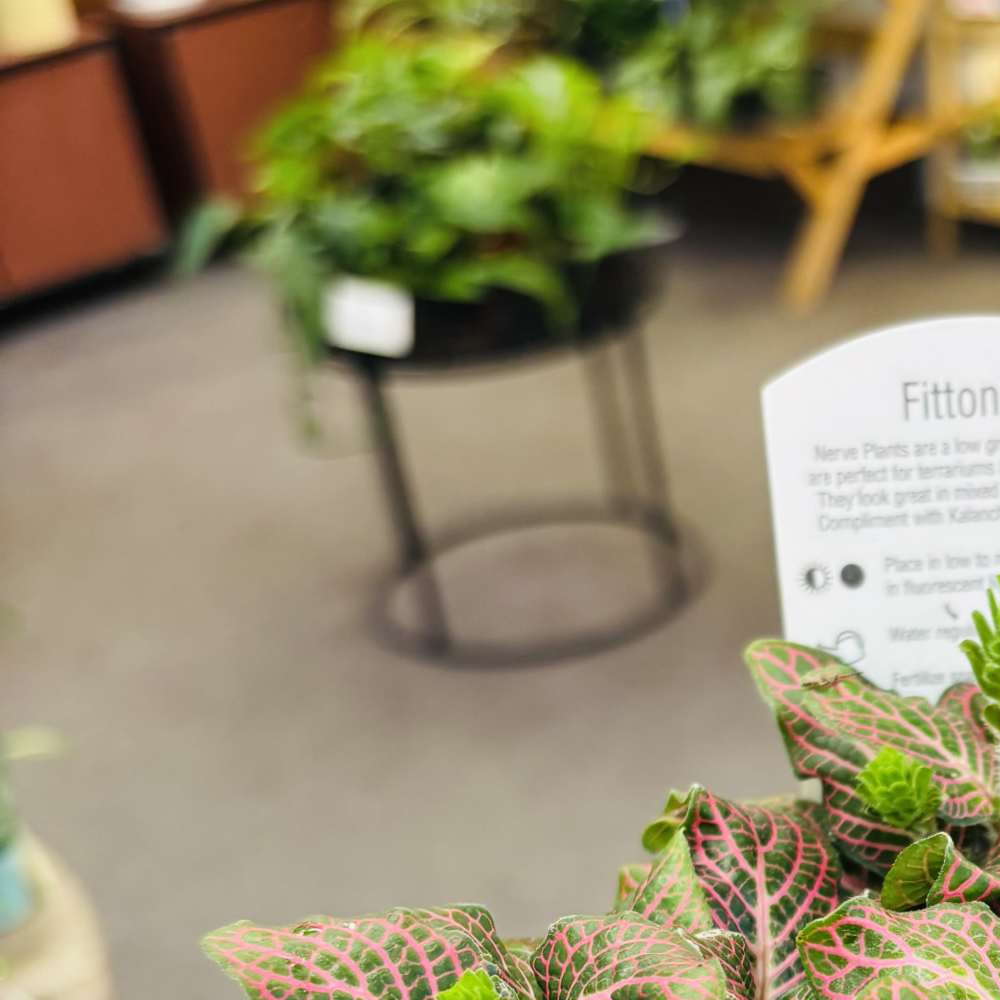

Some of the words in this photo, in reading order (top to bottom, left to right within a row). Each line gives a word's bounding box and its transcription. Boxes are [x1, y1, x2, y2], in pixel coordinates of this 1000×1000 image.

[814, 443, 858, 462] Nerve
[863, 440, 910, 460] Plants
[914, 442, 938, 458] are
[941, 442, 951, 456] a
[954, 436, 980, 454] low
[808, 471, 833, 487] are
[836, 466, 888, 488] perfect
[892, 464, 913, 481] for
[917, 460, 994, 481] terrariums
[817, 490, 854, 511] They
[857, 488, 889, 506] look
[894, 488, 931, 507] great
[936, 486, 951, 502] in
[954, 482, 999, 500] mixed
[818, 513, 909, 533] Compliment
[913, 508, 943, 527] with
[884, 555, 923, 573] Place
